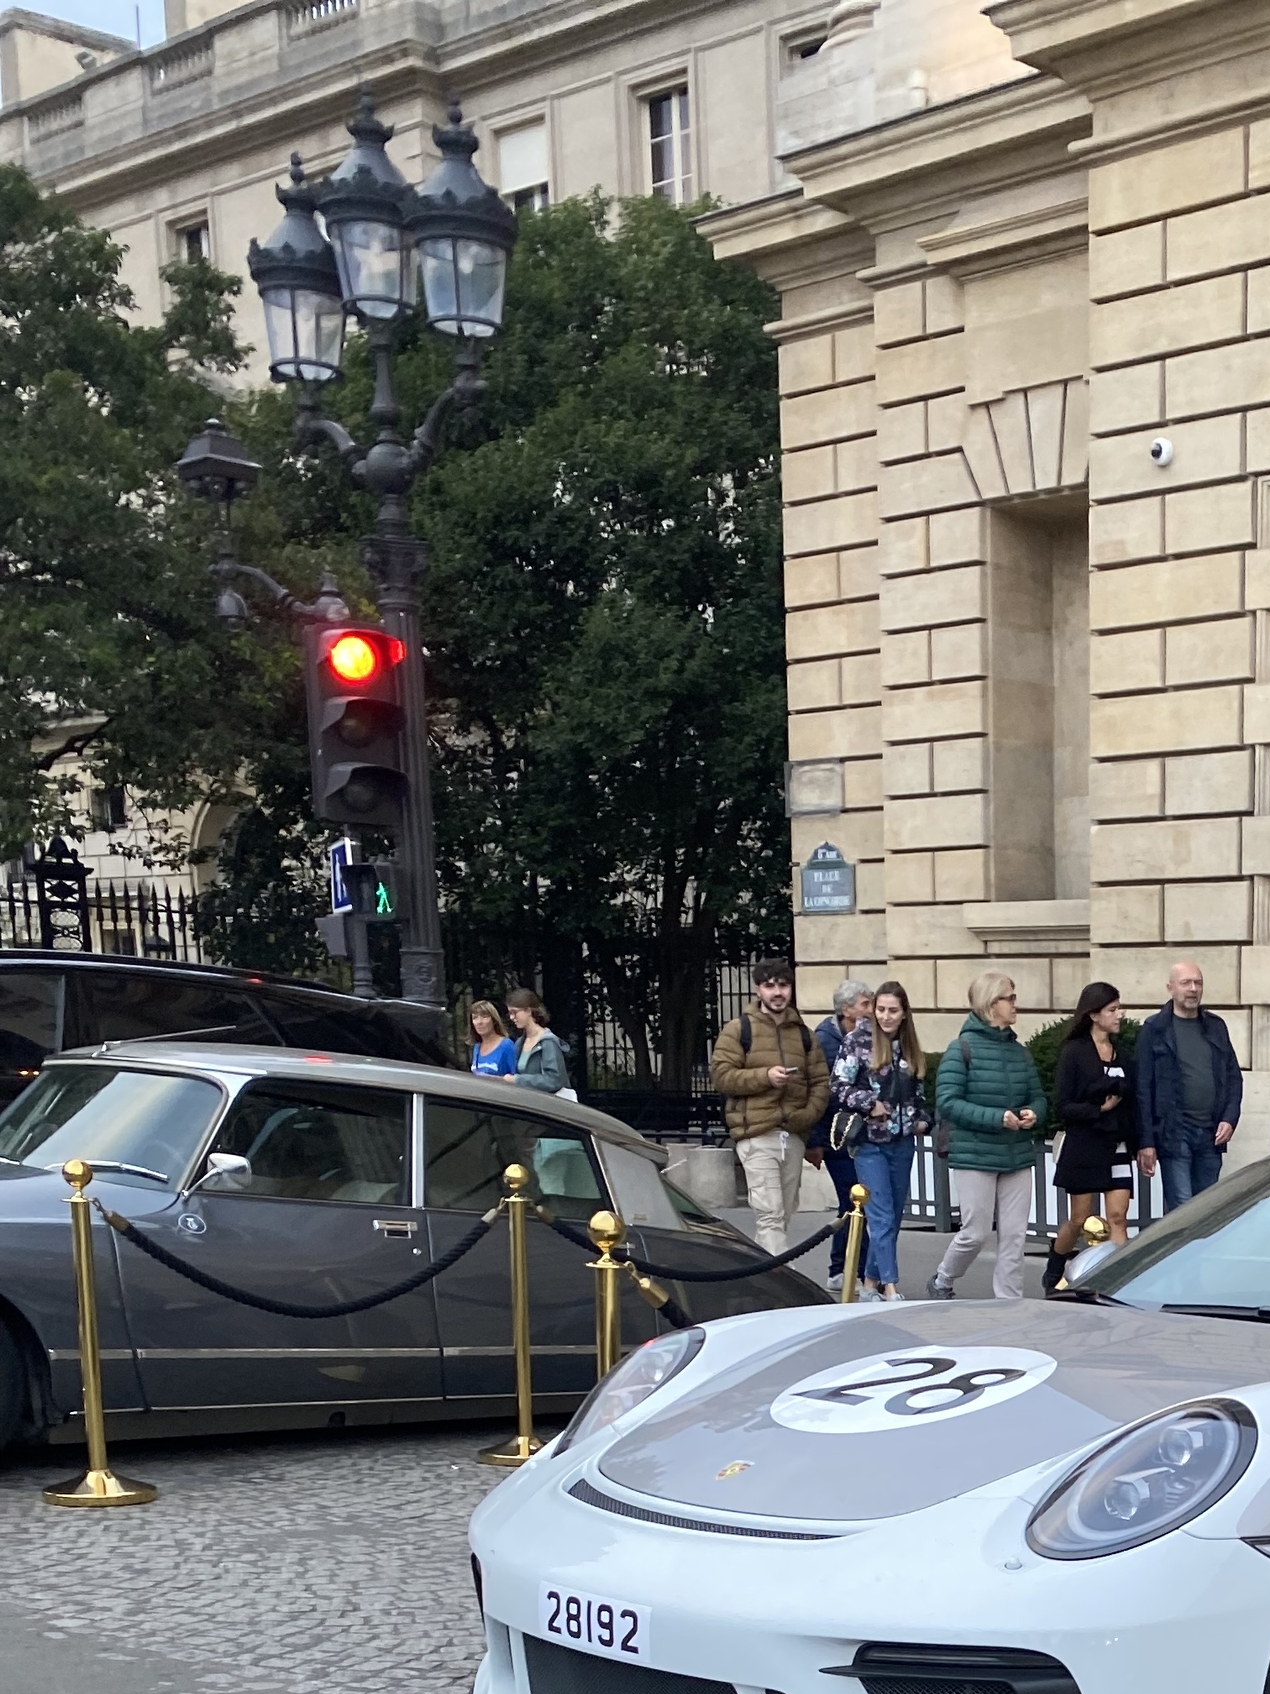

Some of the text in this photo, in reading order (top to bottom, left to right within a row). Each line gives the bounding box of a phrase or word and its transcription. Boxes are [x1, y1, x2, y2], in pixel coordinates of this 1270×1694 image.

[813, 870, 840, 882] PLACE
[822, 884, 833, 893] DE
[789, 1357, 1028, 1415] 28
[547, 1590, 639, 1655] 28192
